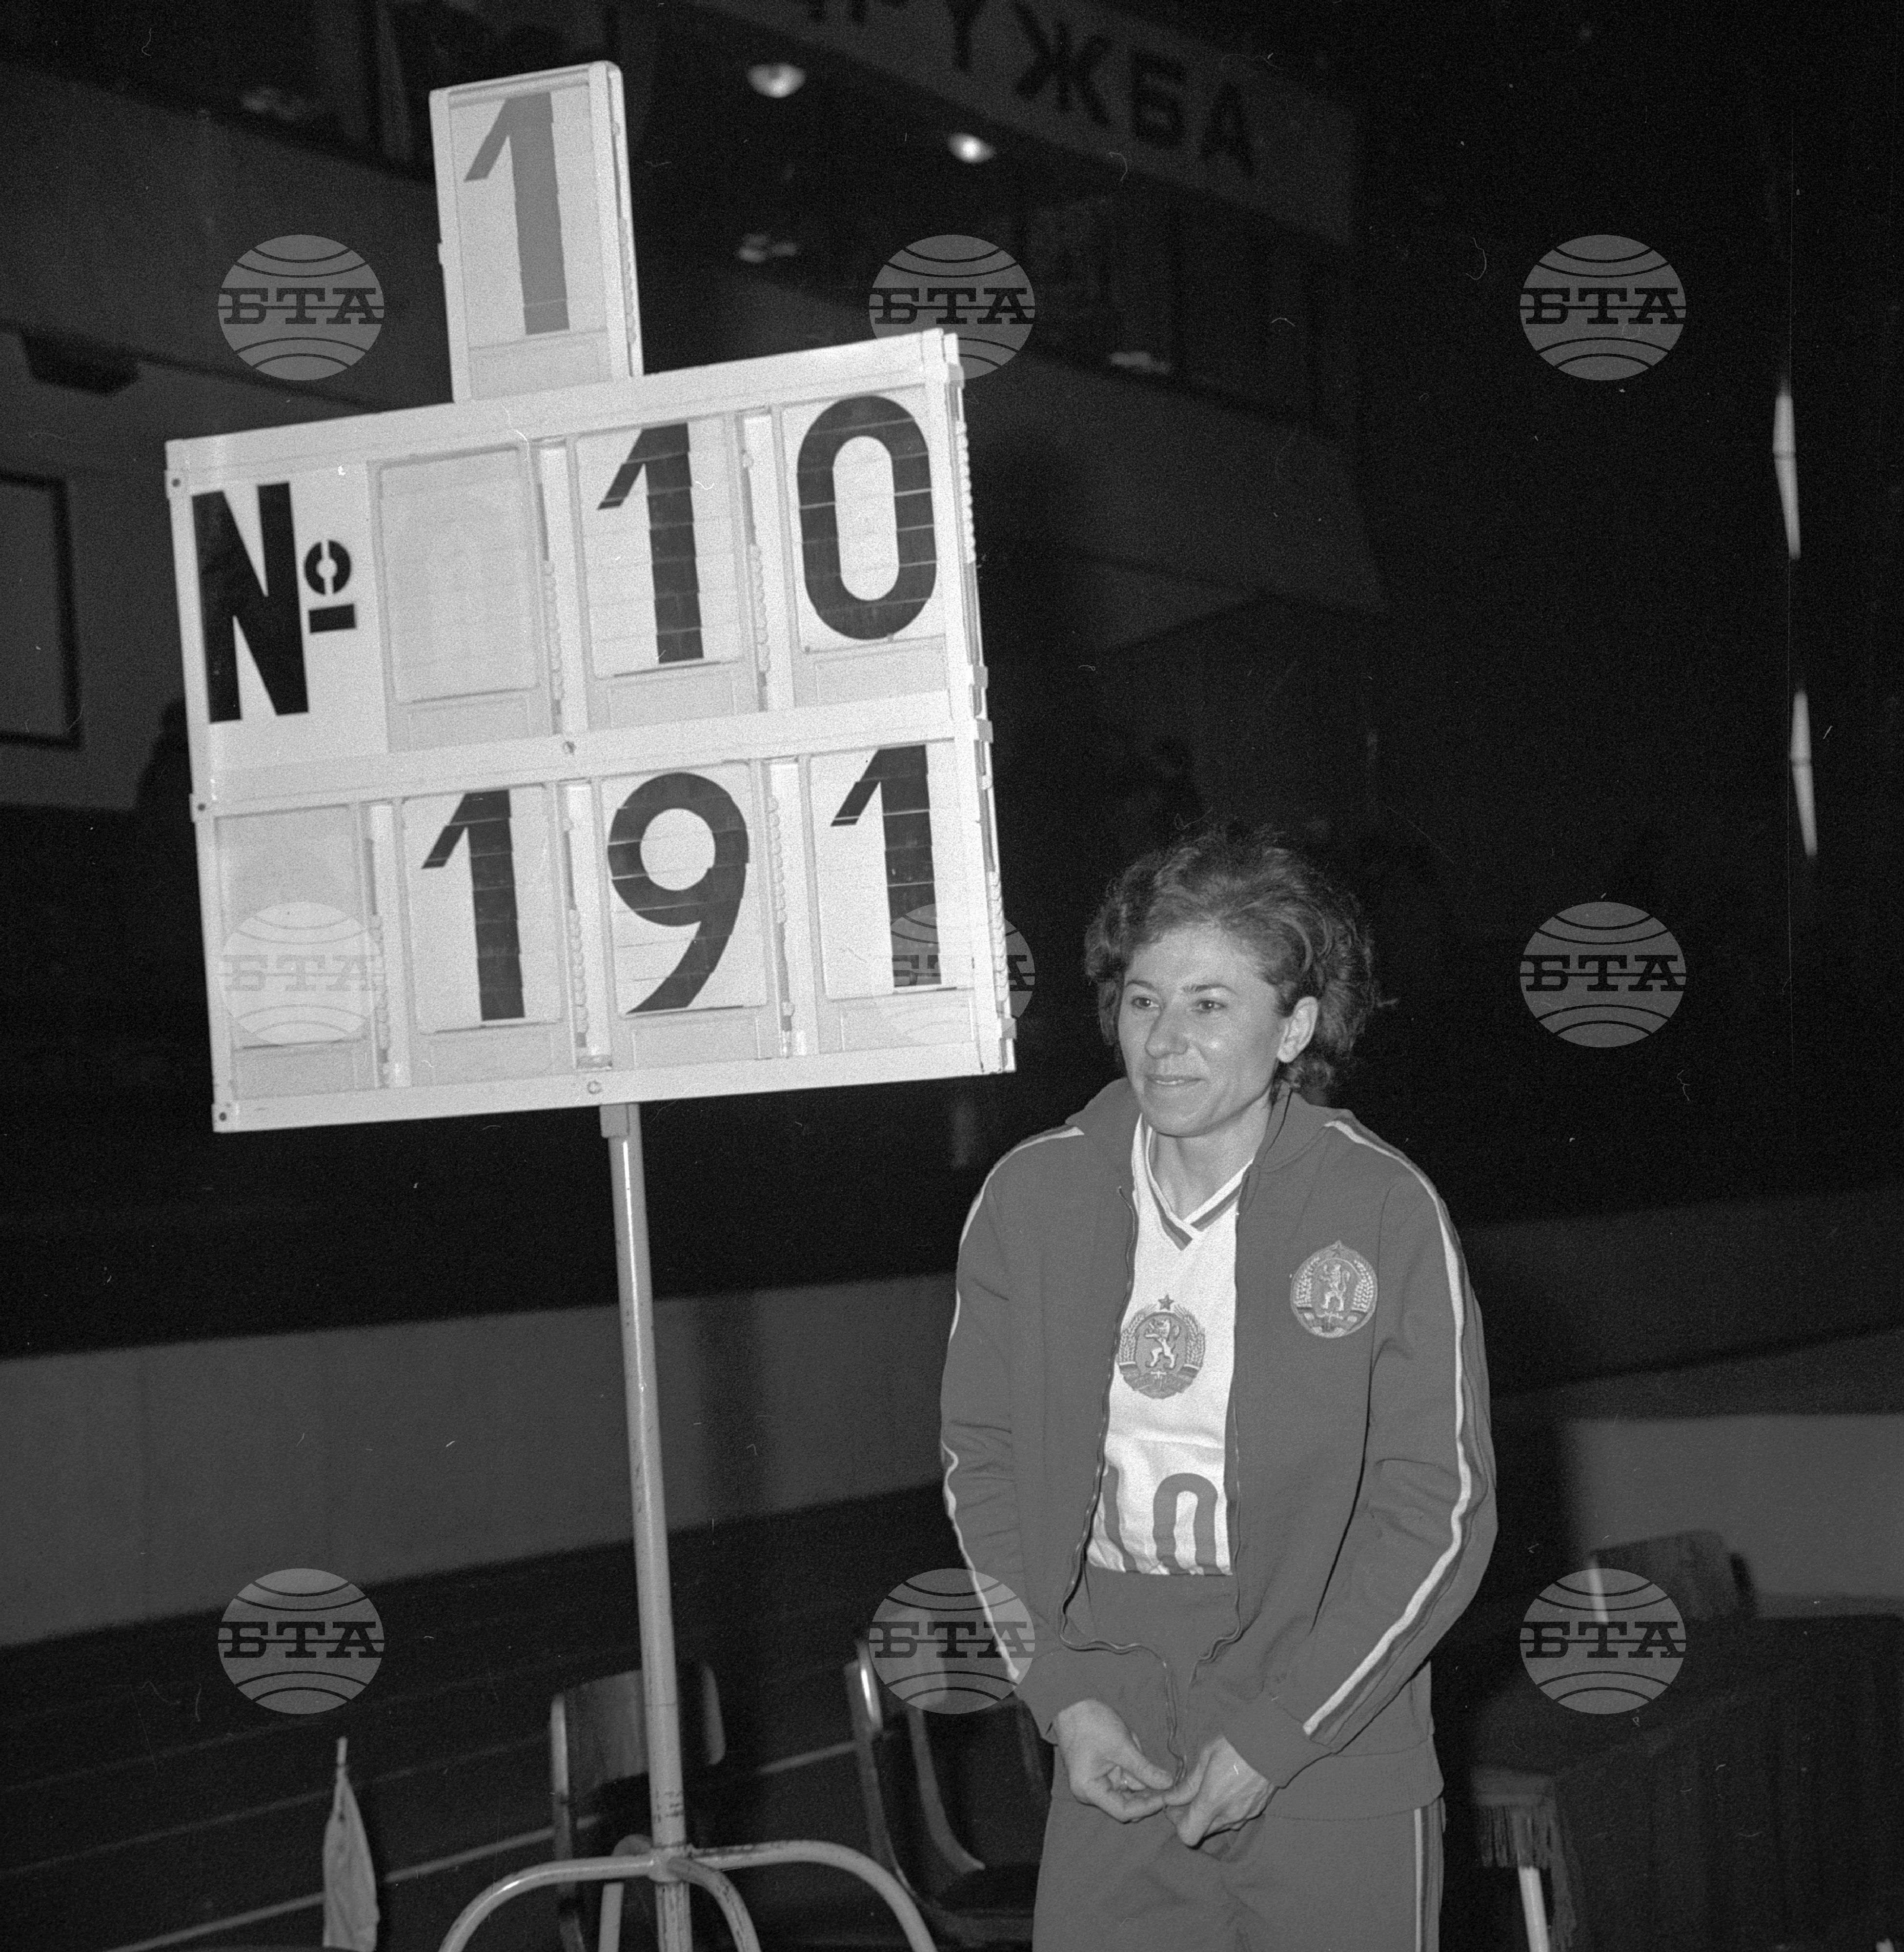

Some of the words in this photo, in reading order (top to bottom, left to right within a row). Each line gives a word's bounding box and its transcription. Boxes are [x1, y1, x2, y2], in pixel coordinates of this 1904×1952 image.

[464, 91, 569, 335] 1
[808, 0, 1256, 178] УЖБА
[598, 395, 937, 664] 10
[422, 744, 941, 1021] 191
